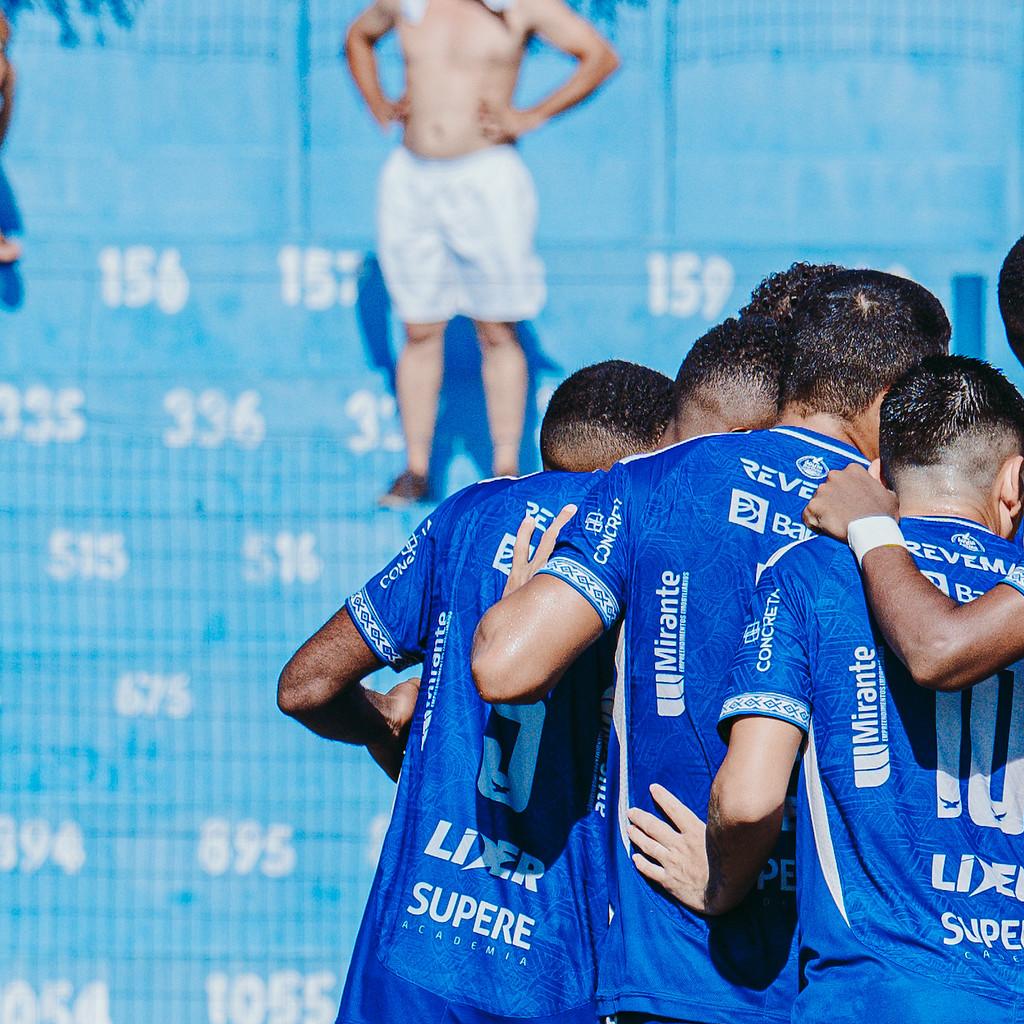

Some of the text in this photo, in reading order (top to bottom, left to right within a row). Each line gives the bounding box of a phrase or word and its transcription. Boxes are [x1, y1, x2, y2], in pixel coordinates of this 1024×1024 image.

[99, 244, 189, 314] 156
[647, 251, 735, 320] 159
[163, 387, 266, 450] 336
[49, 530, 128, 581] 515
[244, 531, 323, 585] 516
[654, 570, 681, 672] Mirante
[756, 588, 780, 672] CONCRETA
[115, 672, 193, 719] 675
[849, 646, 879, 744] Mirante
[198, 817, 297, 877] 895
[401, 921, 528, 966] ACADEMIA
[406, 881, 536, 950] SUPERE
